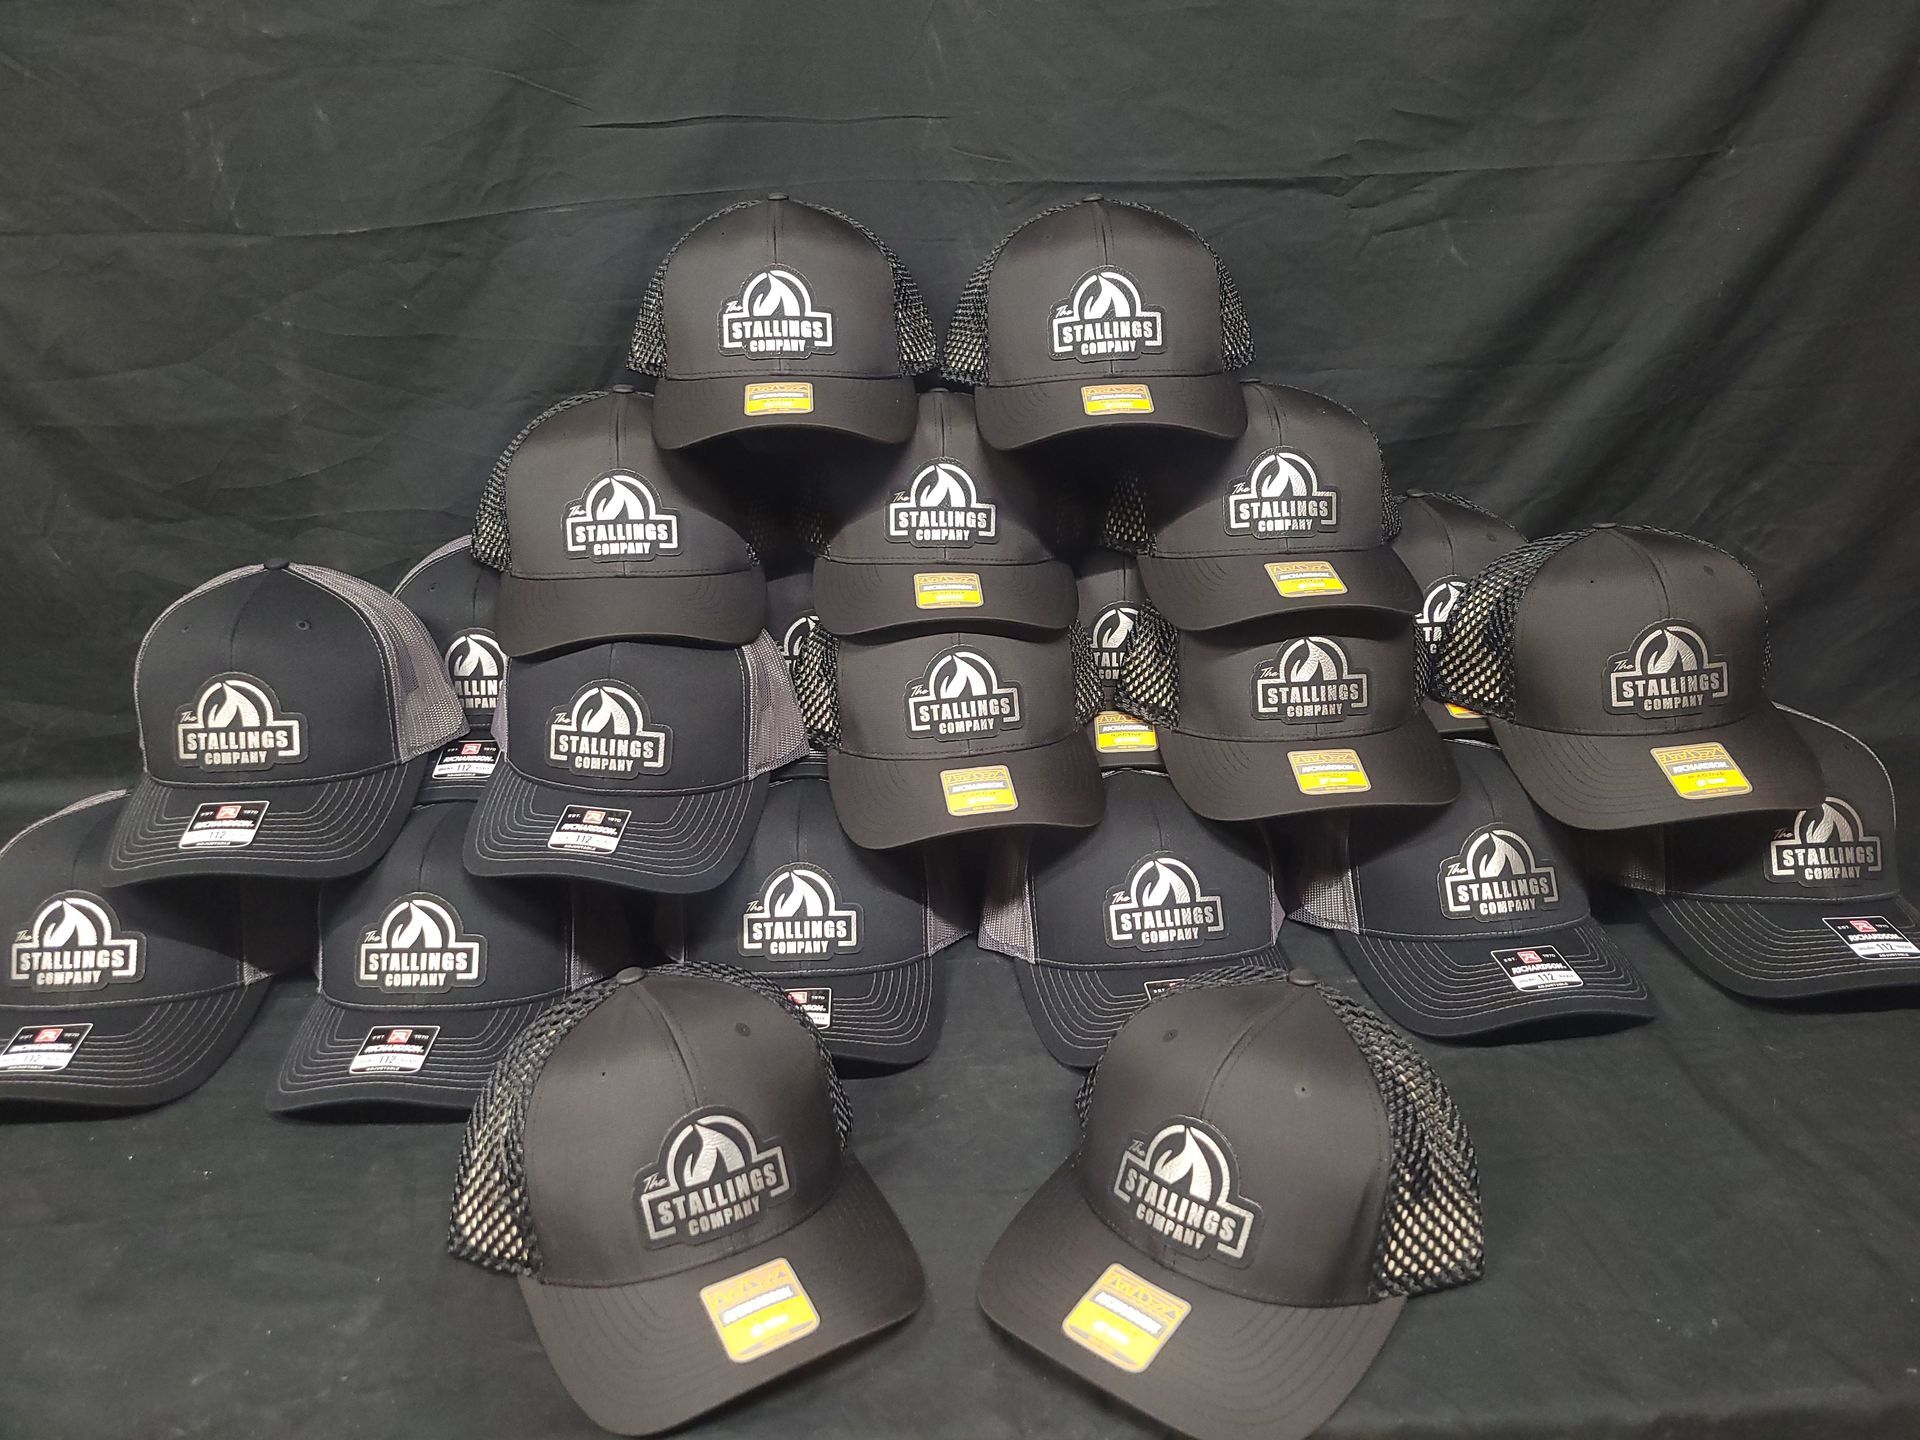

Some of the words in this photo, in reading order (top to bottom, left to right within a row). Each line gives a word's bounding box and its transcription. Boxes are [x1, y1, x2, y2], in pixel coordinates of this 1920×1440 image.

[725, 301, 743, 313] The
[1055, 305, 1074, 318] The
[731, 320, 823, 339] STALLINGS
[1062, 321, 1153, 343] STALLINGS
[750, 339, 805, 352] COMPANY
[1080, 340, 1136, 355] COMPANY
[1232, 482, 1250, 494] The
[893, 491, 910, 502] The
[568, 504, 587, 517] The
[1239, 500, 1329, 520] STALLINGS
[899, 511, 987, 528] STALLINGS
[1257, 518, 1313, 532] COMPANY
[575, 523, 668, 543] STALLINGS
[915, 530, 969, 541] COMPANY
[593, 541, 651, 556] COMPANY
[1260, 666, 1278, 678] The
[1613, 660, 1634, 672] The
[910, 684, 930, 697] The
[1622, 672, 1720, 698] STALLINGS
[1267, 684, 1359, 704] STALLINGS
[919, 697, 1010, 722] STALLINGS
[1286, 703, 1342, 717] COMPANY
[1643, 694, 1704, 711] COMPANY
[180, 711, 197, 723] The
[553, 712, 570, 724] The
[939, 718, 994, 735] COMPANY
[187, 730, 288, 751] STALLINGS
[558, 735, 654, 759] STALLINGS
[204, 750, 267, 765] COMPANY
[574, 756, 634, 772] COMPANY
[209, 830, 226, 839] 112
[576, 835, 591, 843] 112
[1774, 828, 1794, 839] The
[1782, 846, 1874, 866] STALLINGS
[1448, 863, 1467, 876] The
[1804, 865, 1860, 880] COMPANY
[1112, 891, 1131, 904] The
[1456, 877, 1549, 903] STALLINGS
[746, 900, 764, 912] The
[1479, 898, 1535, 915] COMPANY
[1120, 906, 1214, 931] STALLINGS
[14, 930, 33, 942] The
[363, 930, 382, 942] The
[752, 920, 847, 941] STALLINGS
[1140, 927, 1198, 944] COMPANY
[770, 940, 829, 954] COMPANY
[1876, 943, 1896, 951] 112
[20, 949, 125, 970] STALLINGS
[368, 952, 468, 971] STALLINGS
[36, 970, 101, 985] COMPANY
[384, 972, 446, 986] COMPANY
[1538, 973, 1556, 982] 112
[379, 1055, 397, 1064] 112
[642, 1173, 668, 1193] The
[657, 1162, 778, 1225] STALLINGS
[1124, 1168, 1236, 1241] STALLINGS
[688, 1195, 761, 1236] COMPANY
[1135, 1202, 1207, 1249] COMPANY
